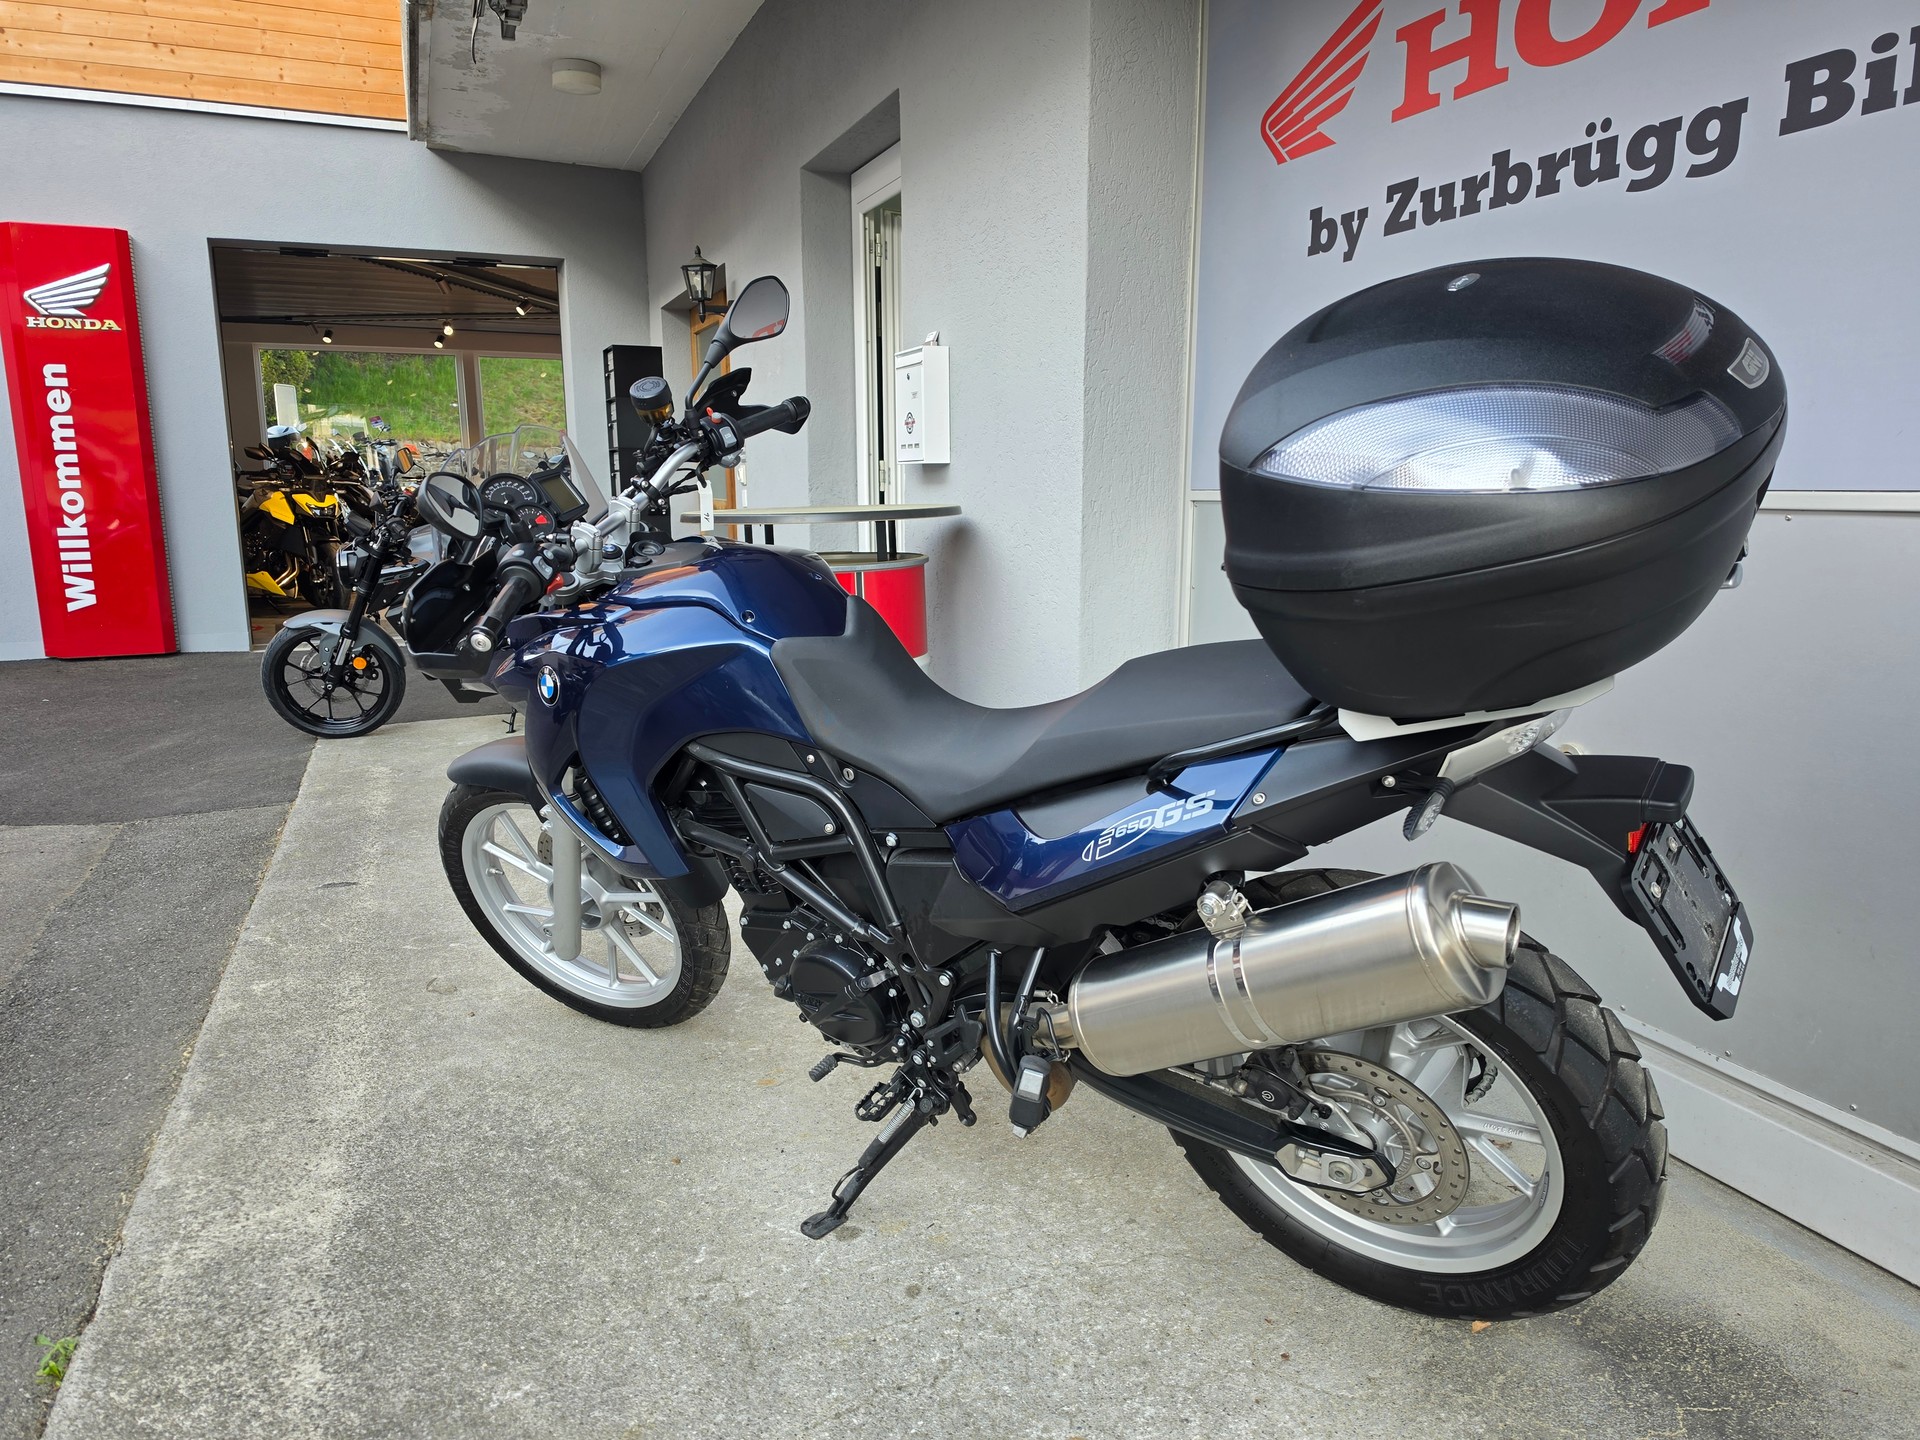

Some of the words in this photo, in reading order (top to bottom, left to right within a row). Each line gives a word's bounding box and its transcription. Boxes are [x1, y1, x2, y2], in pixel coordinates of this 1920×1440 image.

[1391, 0, 1713, 123] HO
[1307, 206, 1369, 263] by
[1383, 97, 1749, 236] Zurbrügg
[26, 316, 121, 331] HONDA
[43, 363, 97, 613] Willkommen
[1415, 1233, 1589, 1307] TOURANCE
